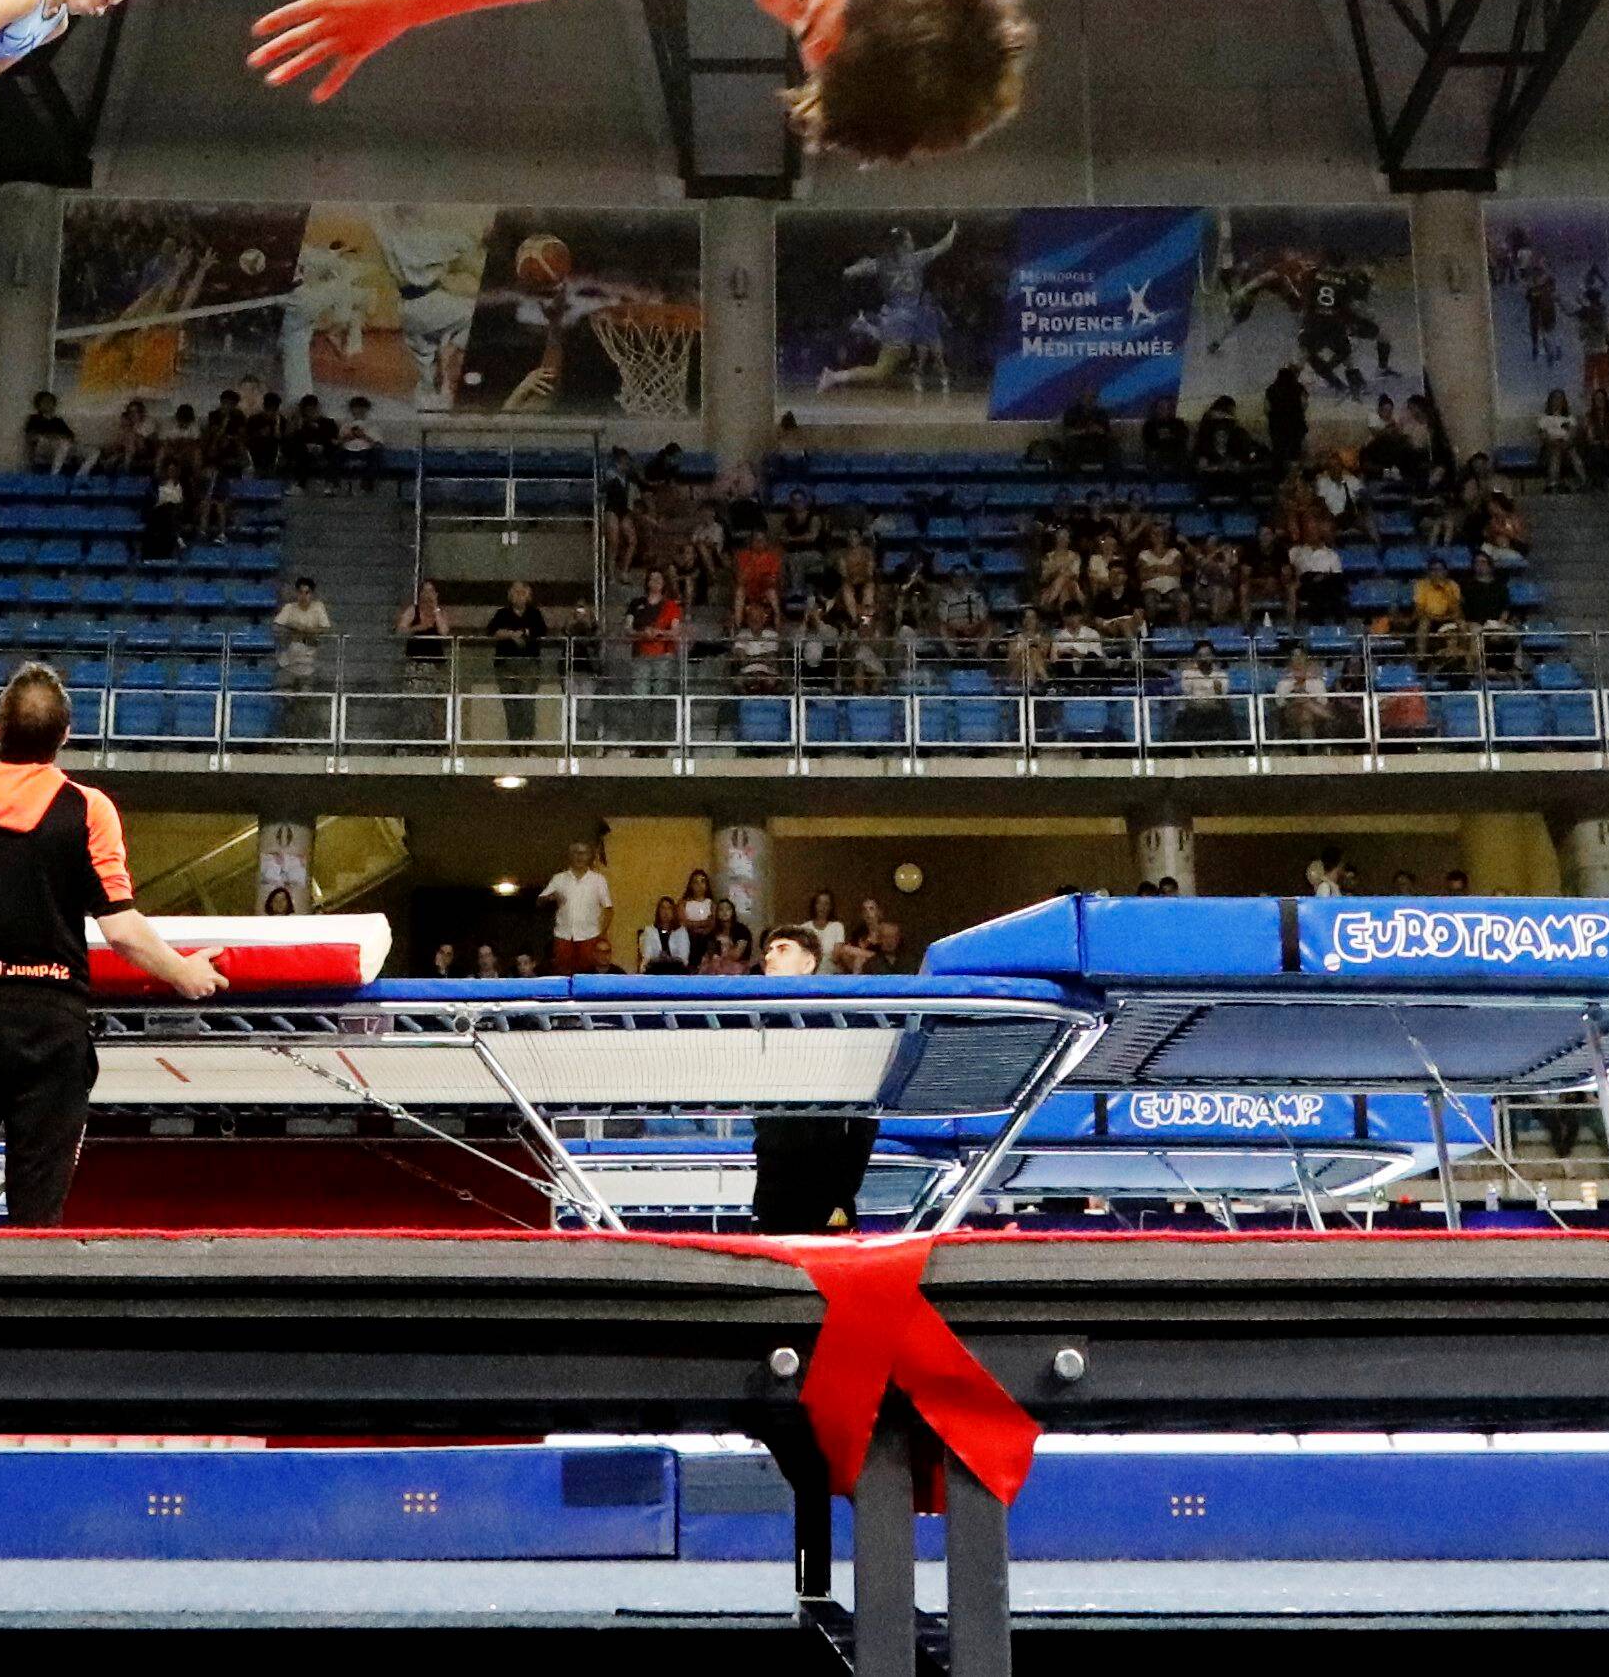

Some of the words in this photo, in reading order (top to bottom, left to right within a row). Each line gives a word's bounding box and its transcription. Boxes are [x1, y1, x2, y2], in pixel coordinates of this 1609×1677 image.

[1020, 285, 1098, 308] TOULON
[1316, 285, 1336, 307] 8
[1020, 310, 1124, 332] PROVENCE
[1021, 335, 1174, 358] MÉDITERRANÉE
[1130, 1091, 1323, 1129] EUROTRAMP
